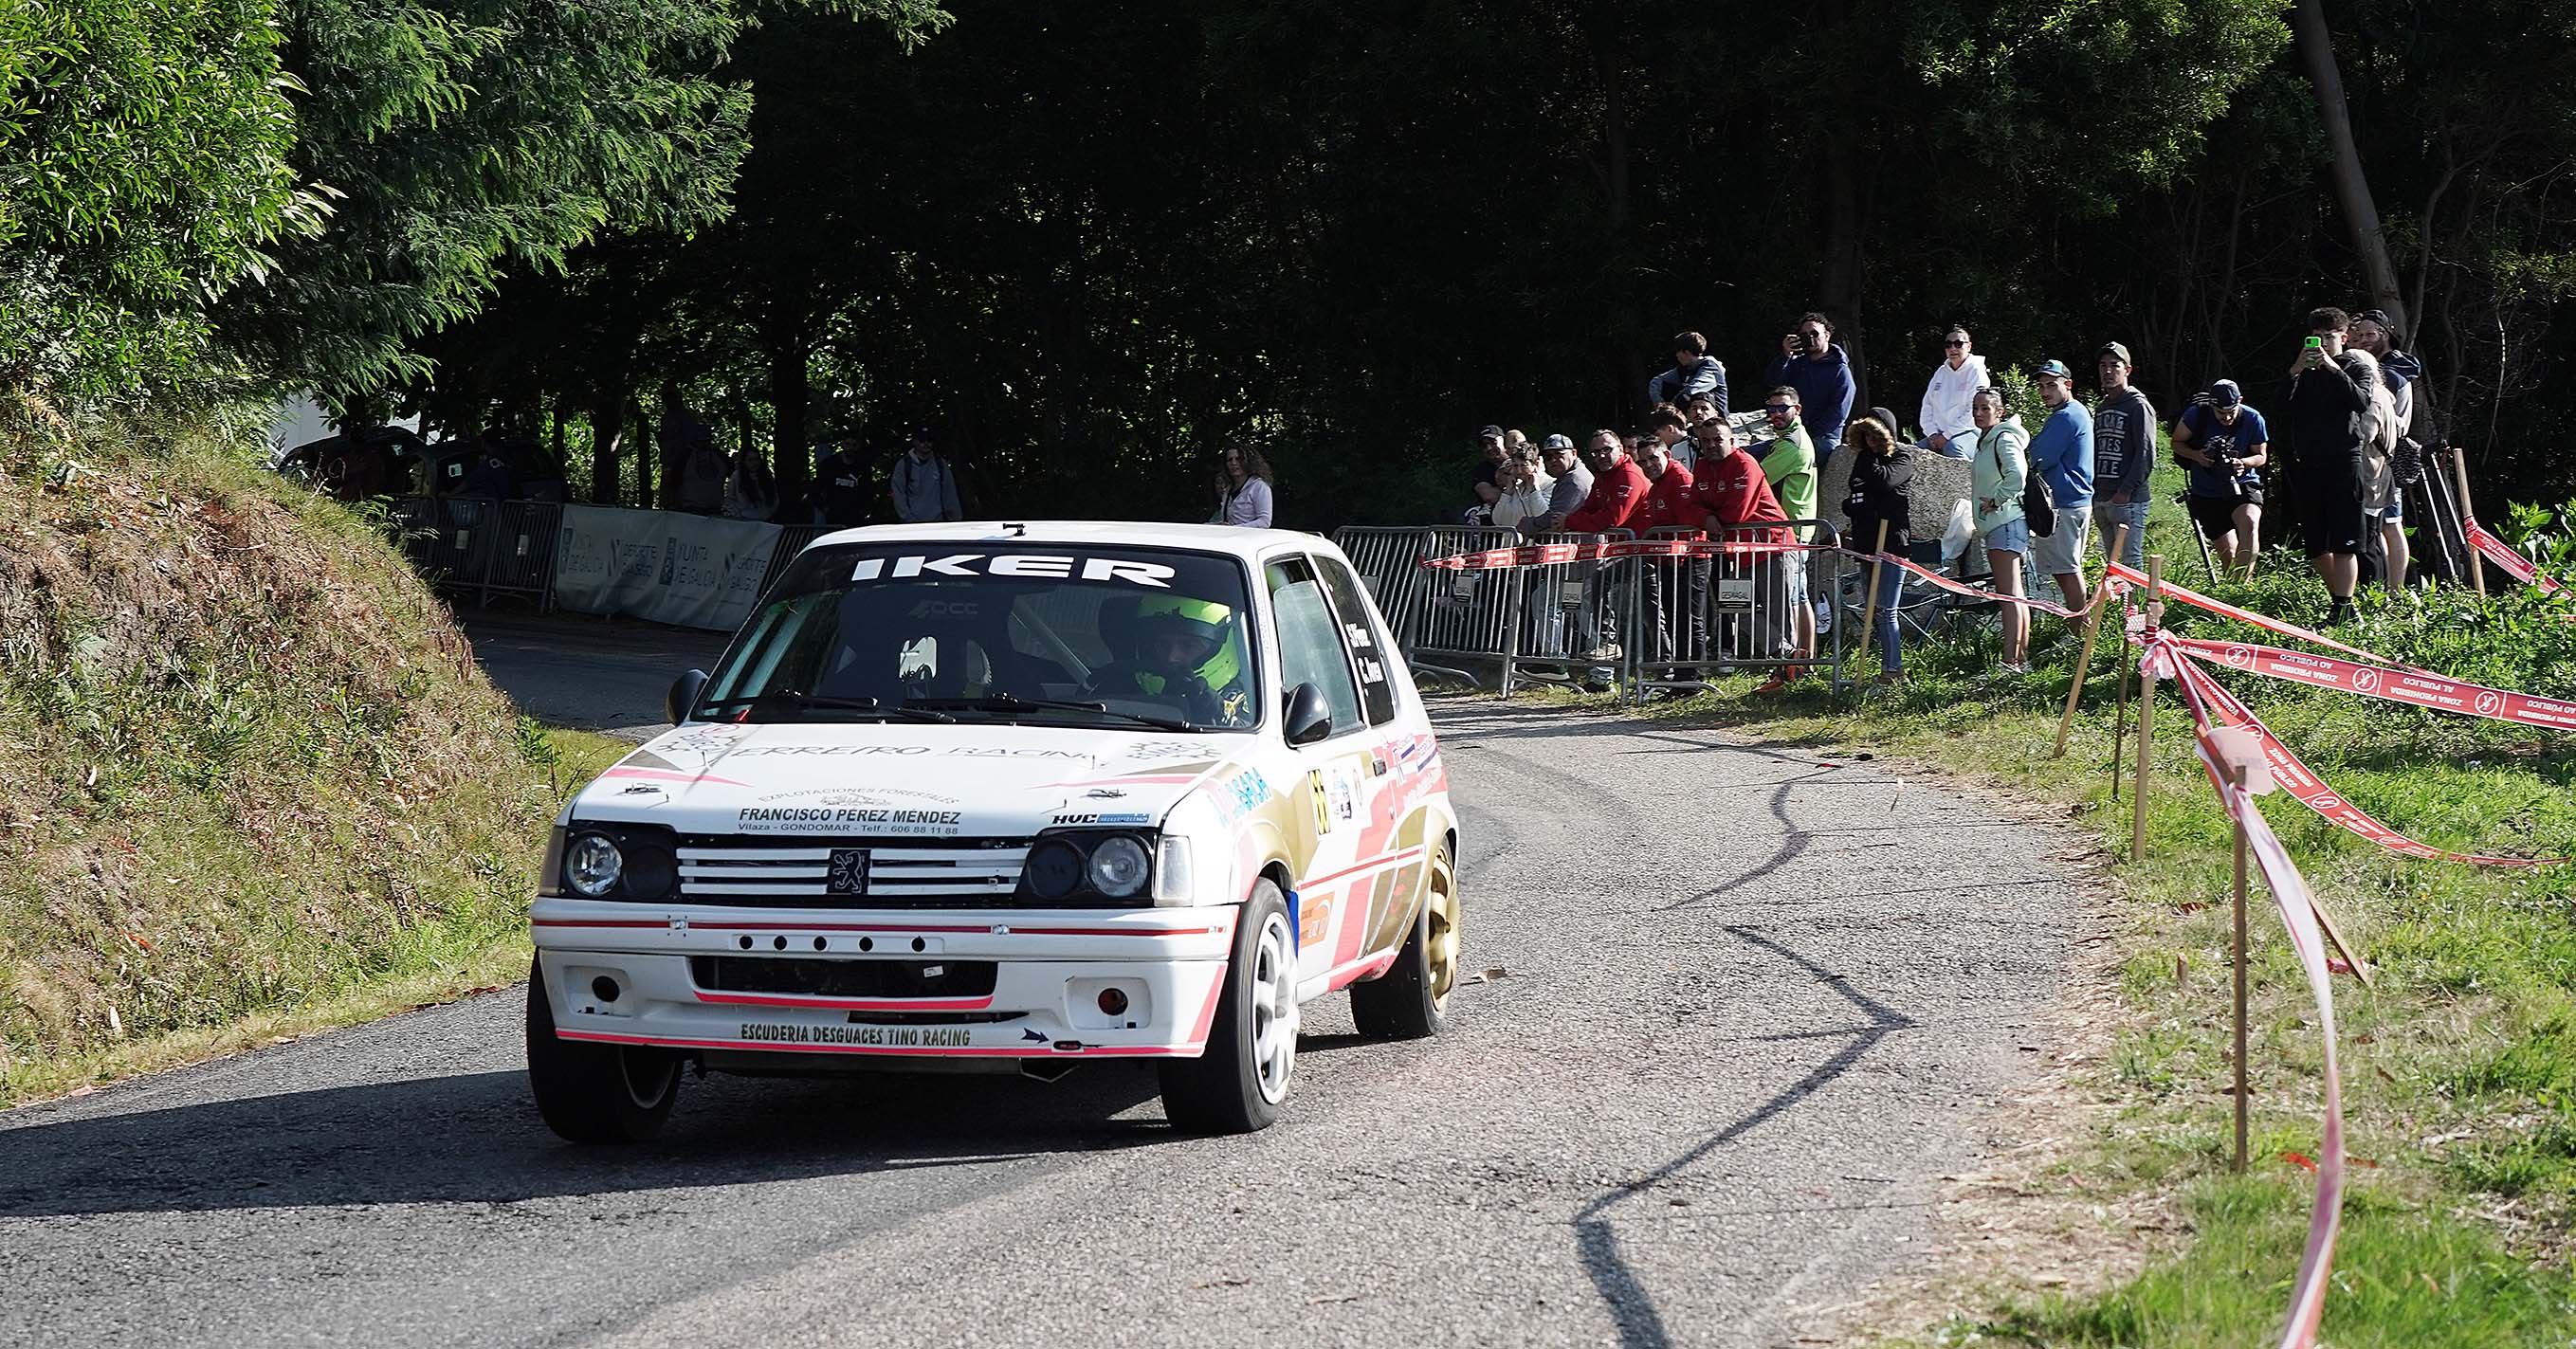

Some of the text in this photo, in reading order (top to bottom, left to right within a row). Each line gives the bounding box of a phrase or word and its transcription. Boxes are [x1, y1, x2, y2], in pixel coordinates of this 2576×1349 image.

[851, 555, 1176, 588] IKER
[2318, 661, 2334, 669] AO
[2269, 663, 2339, 683] ZONA PROHIBIDA
[2389, 685, 2464, 706] ZONA PROHIBIDA
[2440, 684, 2455, 693] AL
[2517, 708, 2557, 722] PROHIBIDA
[758, 788, 875, 803] EXPLOTACIONES
[739, 808, 832, 822] FRANCISCO
[1051, 813, 1097, 825] HVC
[739, 823, 771, 831] Vilaza
[780, 823, 850, 832] GONDOMAR
[890, 825, 910, 833] 606
[930, 826, 941, 834] 11
[944, 827, 959, 835] 88
[740, 1023, 971, 1047] ESCUDERIA DESGUACES TINO RACING
